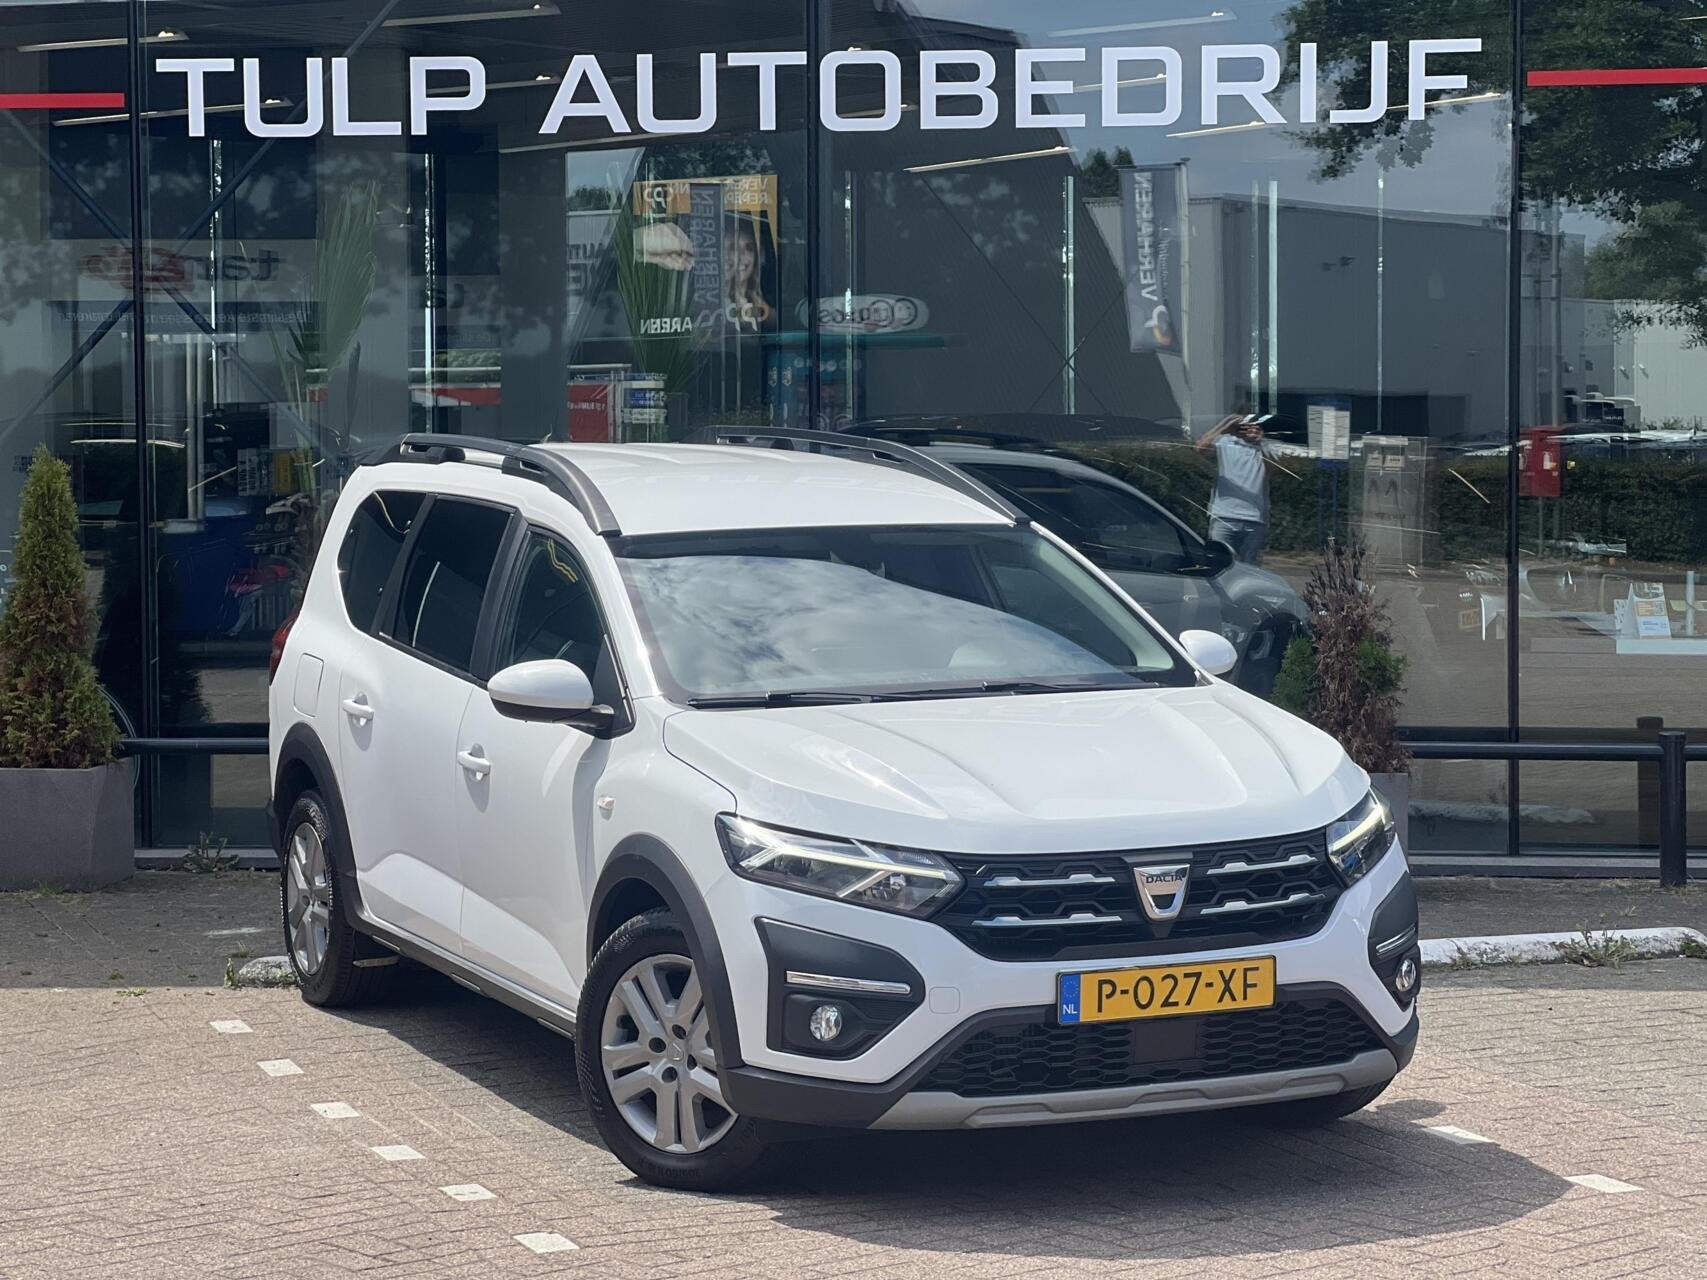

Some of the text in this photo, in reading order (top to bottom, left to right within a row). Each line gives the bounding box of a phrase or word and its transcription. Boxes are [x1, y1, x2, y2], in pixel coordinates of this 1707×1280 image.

[155, 38, 1482, 138] TULP AUTOBEDRIJF
[1146, 874, 1183, 884] DACIA
[1062, 966, 1260, 1016] NL P-027-XF
